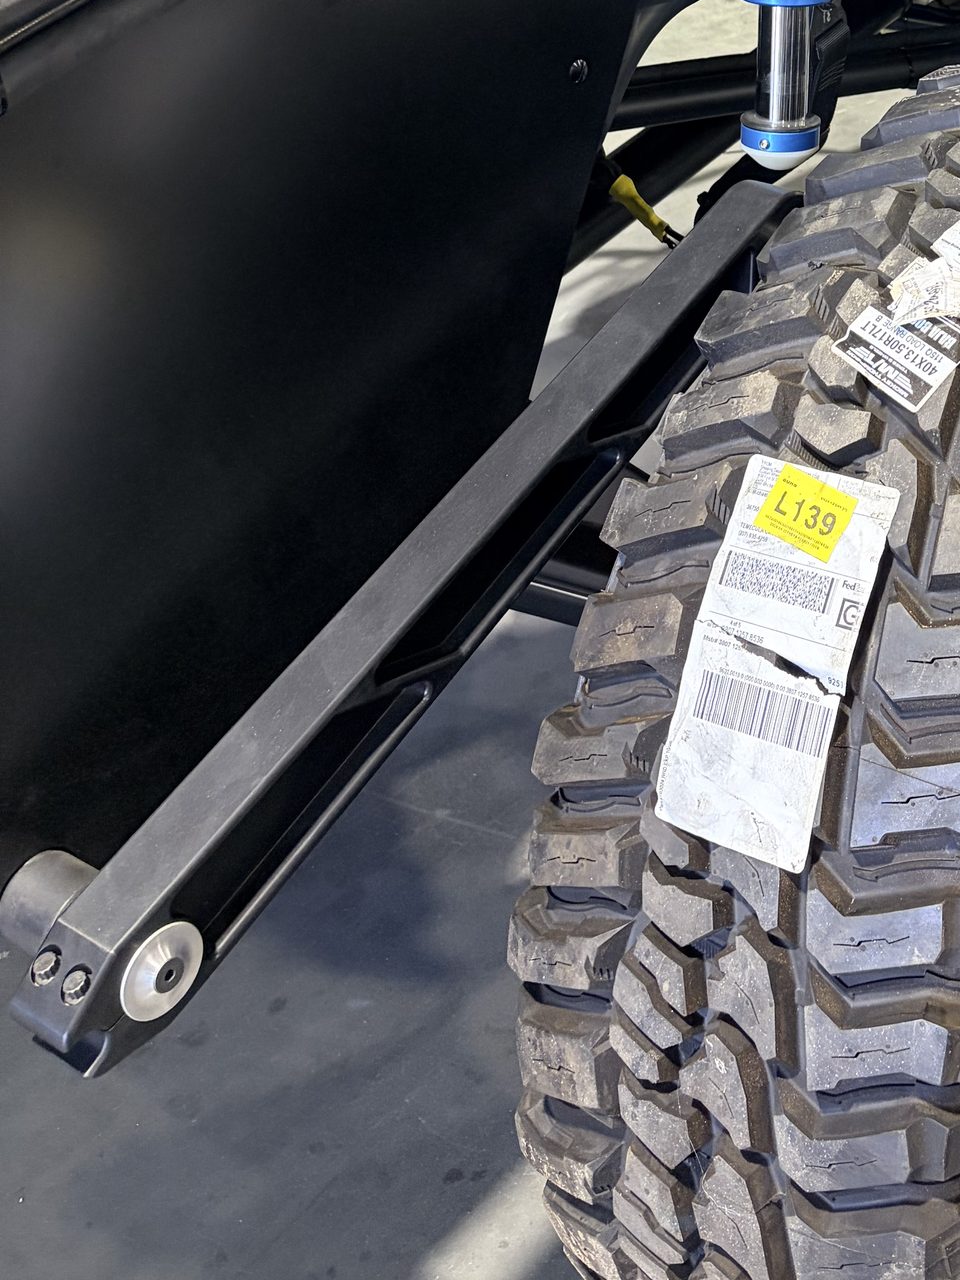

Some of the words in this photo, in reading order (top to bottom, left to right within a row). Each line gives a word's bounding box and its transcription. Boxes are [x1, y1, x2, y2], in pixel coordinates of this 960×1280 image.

[881, 317, 907, 339] RANGE
[927, 324, 956, 350] BAJA
[859, 318, 939, 377] 40X13.50R17LT
[904, 333, 925, 350] LOAD
[864, 352, 901, 380] M/T
[924, 347, 943, 363] 115Q
[774, 490, 836, 535] L139
